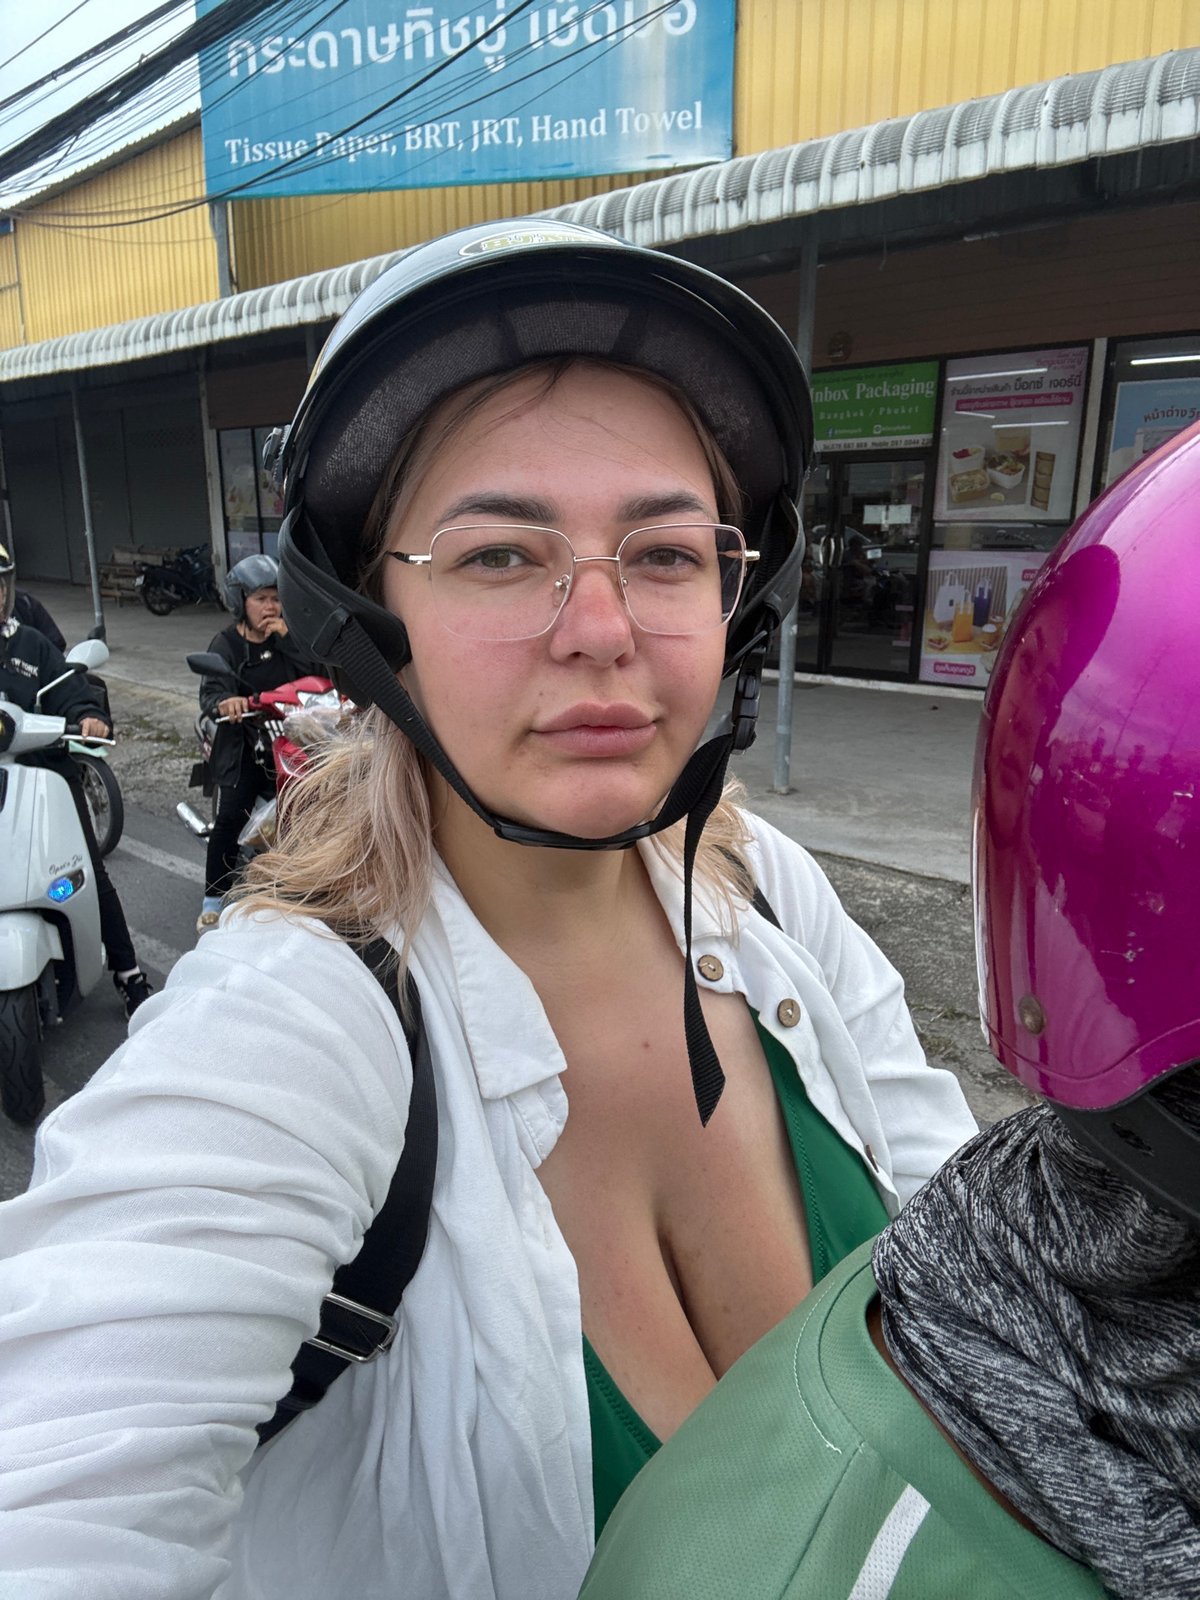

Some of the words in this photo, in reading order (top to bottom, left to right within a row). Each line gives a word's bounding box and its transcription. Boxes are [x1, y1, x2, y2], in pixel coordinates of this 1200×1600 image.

[224, 138, 307, 165] Tissue
[315, 131, 397, 162] Paper,
[404, 121, 464, 151] BRT,
[471, 117, 523, 153] JRT,
[531, 108, 607, 142] Hand
[615, 101, 703, 134] Towel
[856, 379, 935, 400] Packaging
